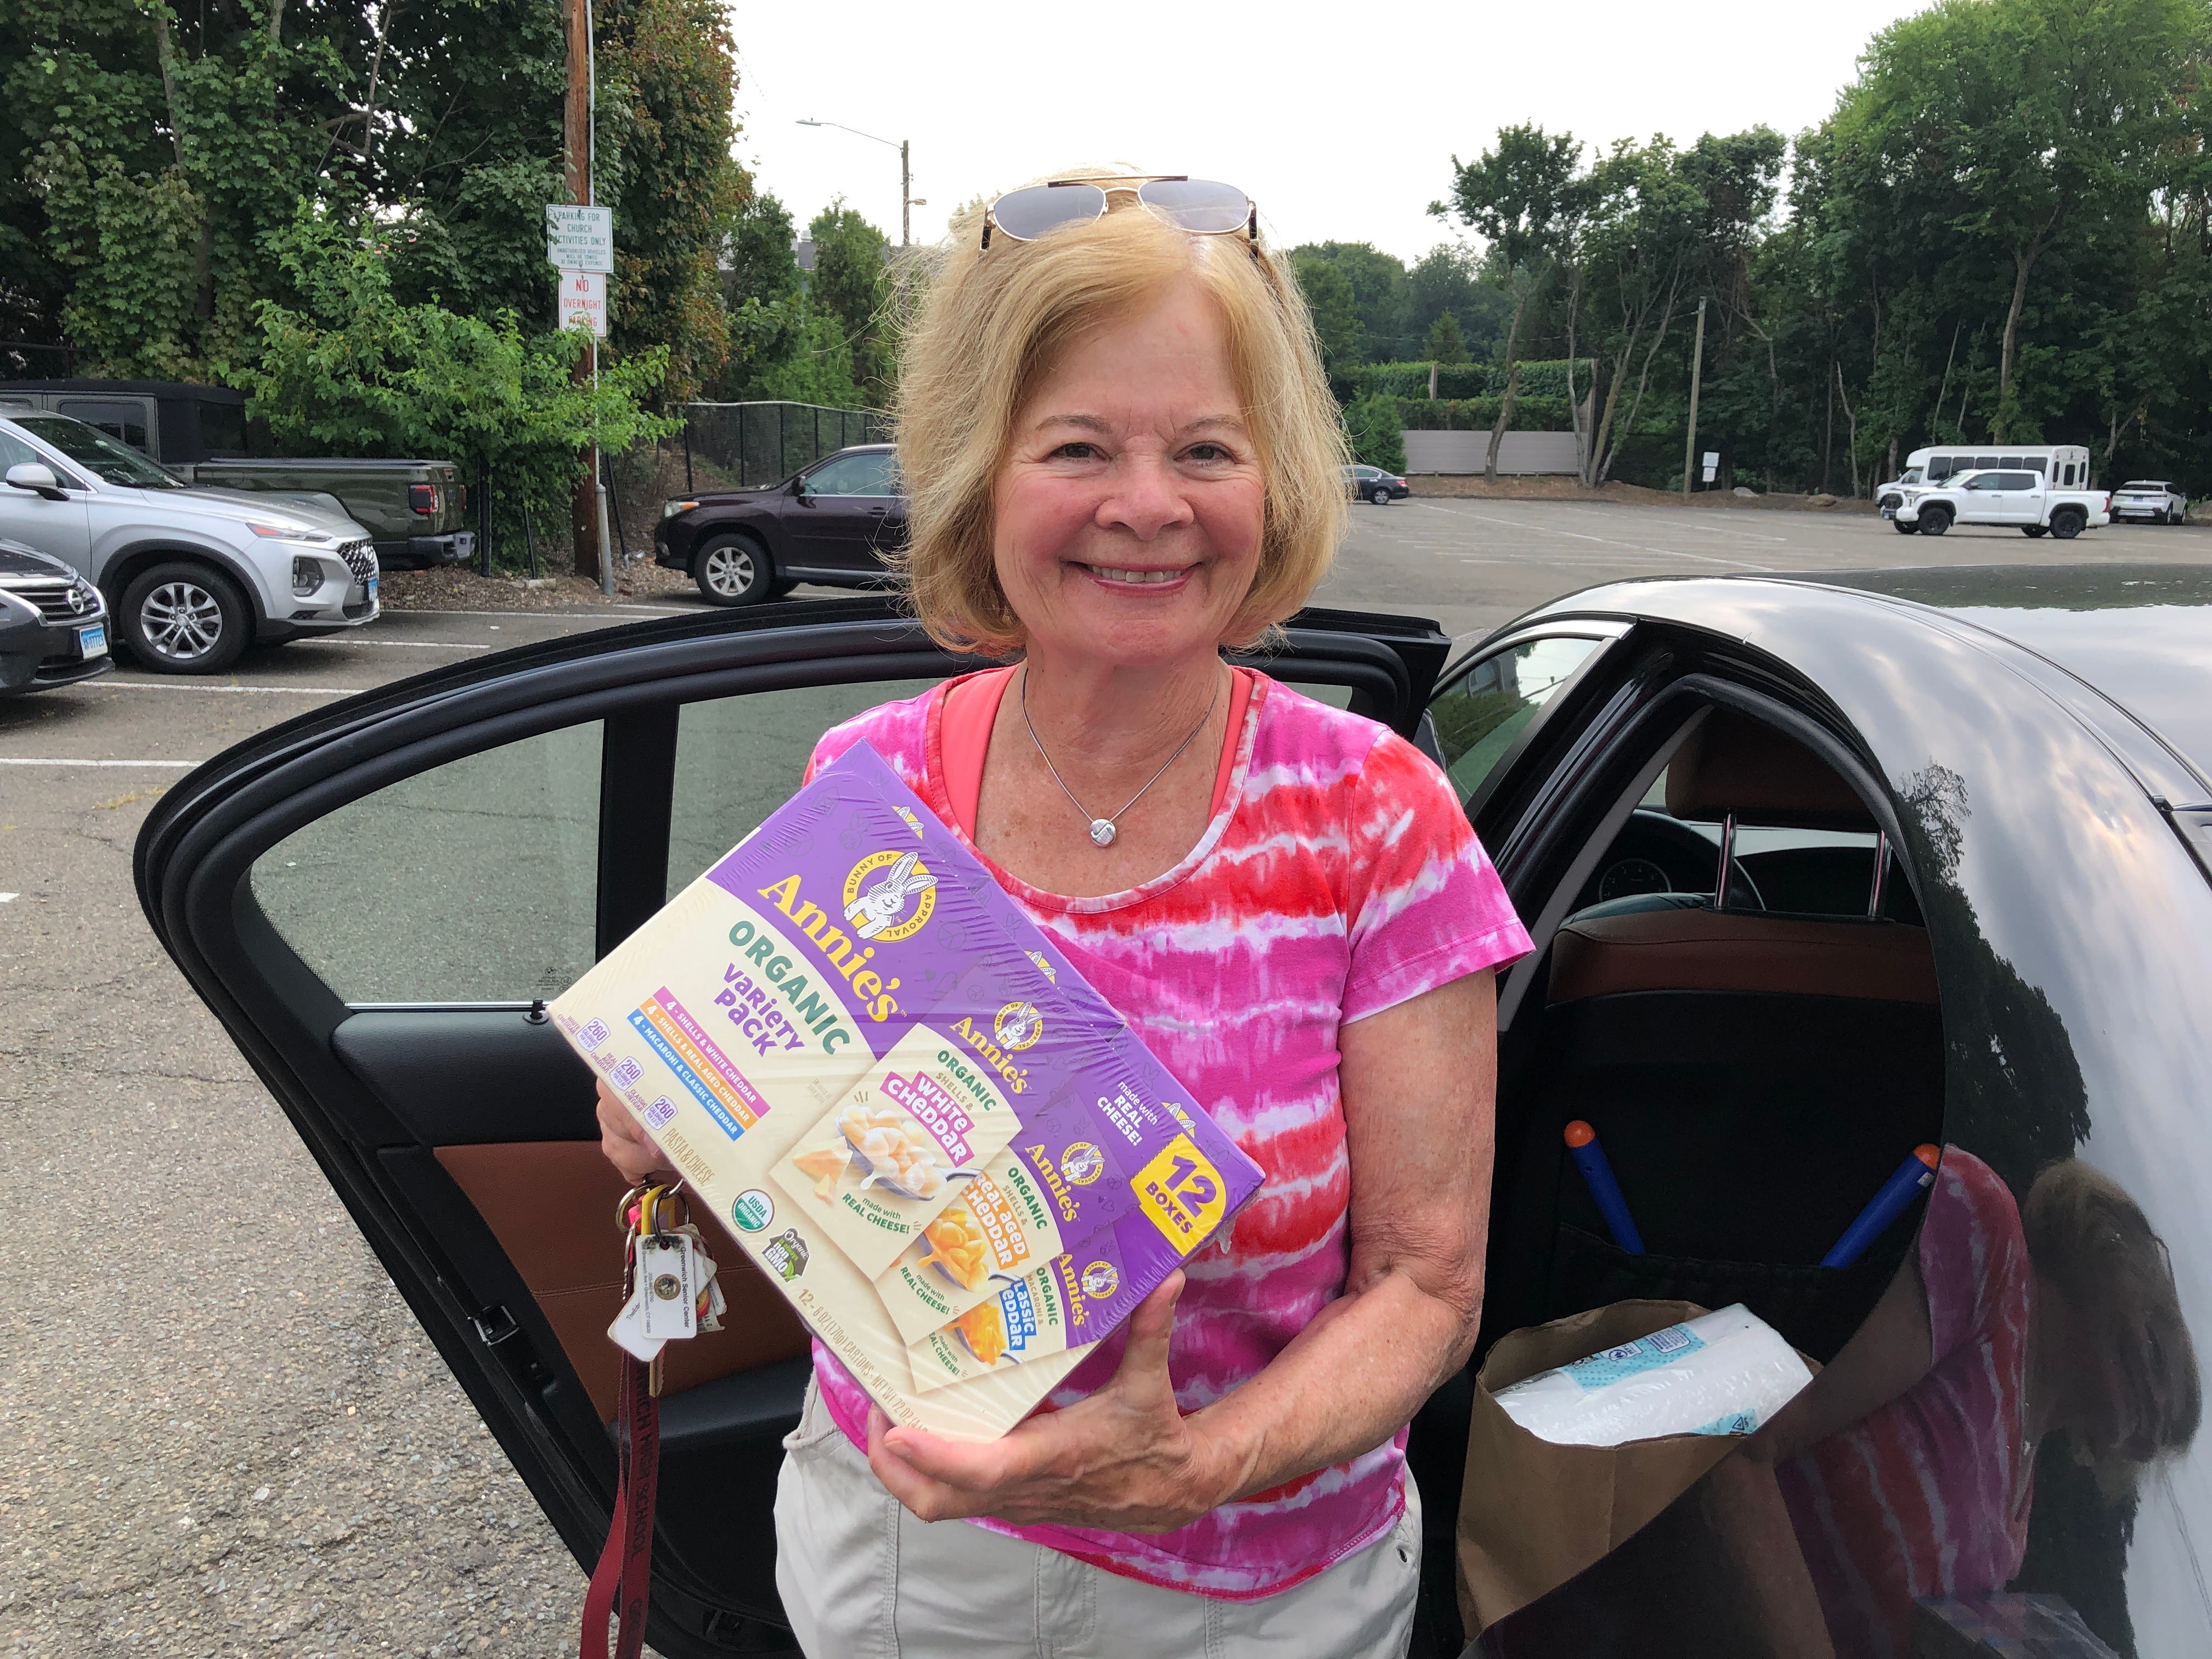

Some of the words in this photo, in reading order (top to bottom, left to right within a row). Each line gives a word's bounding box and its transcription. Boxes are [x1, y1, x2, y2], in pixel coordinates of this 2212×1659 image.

[558, 211, 585, 221] PARKING
[588, 213, 600, 221] FOR
[567, 223, 592, 233] CHURCH
[591, 236, 606, 246] ONLY
[575, 279, 589, 292] NO
[563, 298, 601, 310] OVERNIGHT
[568, 315, 597, 327] PARKNG
[847, 857, 874, 894] BUNNY
[877, 854, 892, 862] OF
[886, 894, 933, 938] APPROVAL
[757, 874, 901, 1023] Annie's
[729, 920, 850, 1055] ORGANIC
[666, 1000, 677, 1011] 4
[996, 1006, 1009, 1026] BUNNY
[557, 1013, 577, 1036] CHEDDAR
[567, 1015, 581, 1031] WHITE
[588, 1020, 608, 1041] 260
[676, 1013, 702, 1041] SHELLS
[1018, 1023, 1041, 1049] APPROVAL
[582, 1029, 599, 1047] CALORIES
[699, 1038, 708, 1046] &
[590, 1052, 610, 1074] CHEDDAR
[603, 1057, 614, 1070] AGED
[606, 1052, 618, 1065] REAL
[647, 1005, 658, 1015] 4
[658, 1016, 683, 1045] SHELLS
[680, 1042, 689, 1051] &
[686, 1047, 703, 1069] REAL
[701, 1068, 721, 1088] AGED
[718, 1086, 751, 1122] CHEDDAR
[703, 1043, 729, 1070] WHITE
[950, 1017, 1028, 1094] Annie's
[615, 1067, 632, 1086] CALORIES
[621, 1059, 641, 1080] 260
[633, 1015, 645, 1026] 4
[644, 1027, 678, 1066] MACARONI
[676, 1064, 684, 1073] &
[681, 1070, 709, 1101] CLASSIC
[706, 1098, 739, 1135] CHEDDAR
[937, 1050, 997, 1111] ORGANIC
[630, 1088, 648, 1109] CLASSIC
[725, 1067, 757, 1104] CHEDDAR
[936, 1072, 968, 1103] SHELLS
[965, 1102, 974, 1111] &
[624, 1091, 644, 1113] CHEDDAR
[654, 1098, 675, 1120] 260
[1114, 1094, 1144, 1128] REAL
[1118, 1080, 1141, 1106] made
[1138, 1103, 1158, 1125] with
[649, 1106, 666, 1125] CALORIES
[1097, 1096, 1143, 1147] CHEESE!
[662, 1127, 686, 1159] PASTA
[680, 1148, 695, 1164] &
[686, 1153, 715, 1186] CHEESE
[1024, 1143, 1080, 1222] Annie's
[1008, 1166, 1048, 1229] ORGANIC
[1164, 1154, 1217, 1218] 12
[738, 1201, 761, 1229] ORGANIC
[748, 1195, 768, 1218] USDA
[842, 1192, 865, 1217] REAL
[866, 1212, 911, 1234] CHEESE!
[862, 1197, 883, 1213] made
[883, 1209, 901, 1220] with
[1002, 1185, 1024, 1217] SHELLS
[1021, 1218, 1028, 1226] &
[1145, 1181, 1193, 1234] BOXES
[773, 1241, 790, 1260] non
[784, 1229, 810, 1260] Organic
[765, 1247, 788, 1273] GMO
[798, 1289, 814, 1306] 12
[900, 1266, 918, 1290] REAL
[916, 1288, 951, 1316] CHEESE!
[916, 1273, 931, 1291] made
[930, 1288, 945, 1301] with
[1026, 1273, 1042, 1316] MACARONI
[1036, 1267, 1058, 1326] ORGANIC
[1058, 1254, 1090, 1326] Annie's
[812, 1306, 823, 1317] 6
[817, 1311, 833, 1325] OZ
[823, 1321, 850, 1347] (170g)
[842, 1340, 875, 1378] CARTONS
[929, 1331, 939, 1347] EAL
[935, 1346, 960, 1376] CHEESE!
[939, 1335, 949, 1351] made
[947, 1350, 958, 1363] with
[871, 1374, 888, 1392] NET
[882, 1387, 898, 1404] WT
[891, 1397, 906, 1414] 72
[899, 1407, 915, 1419] OZ
[631, 1483, 650, 1563] SCHOOL
